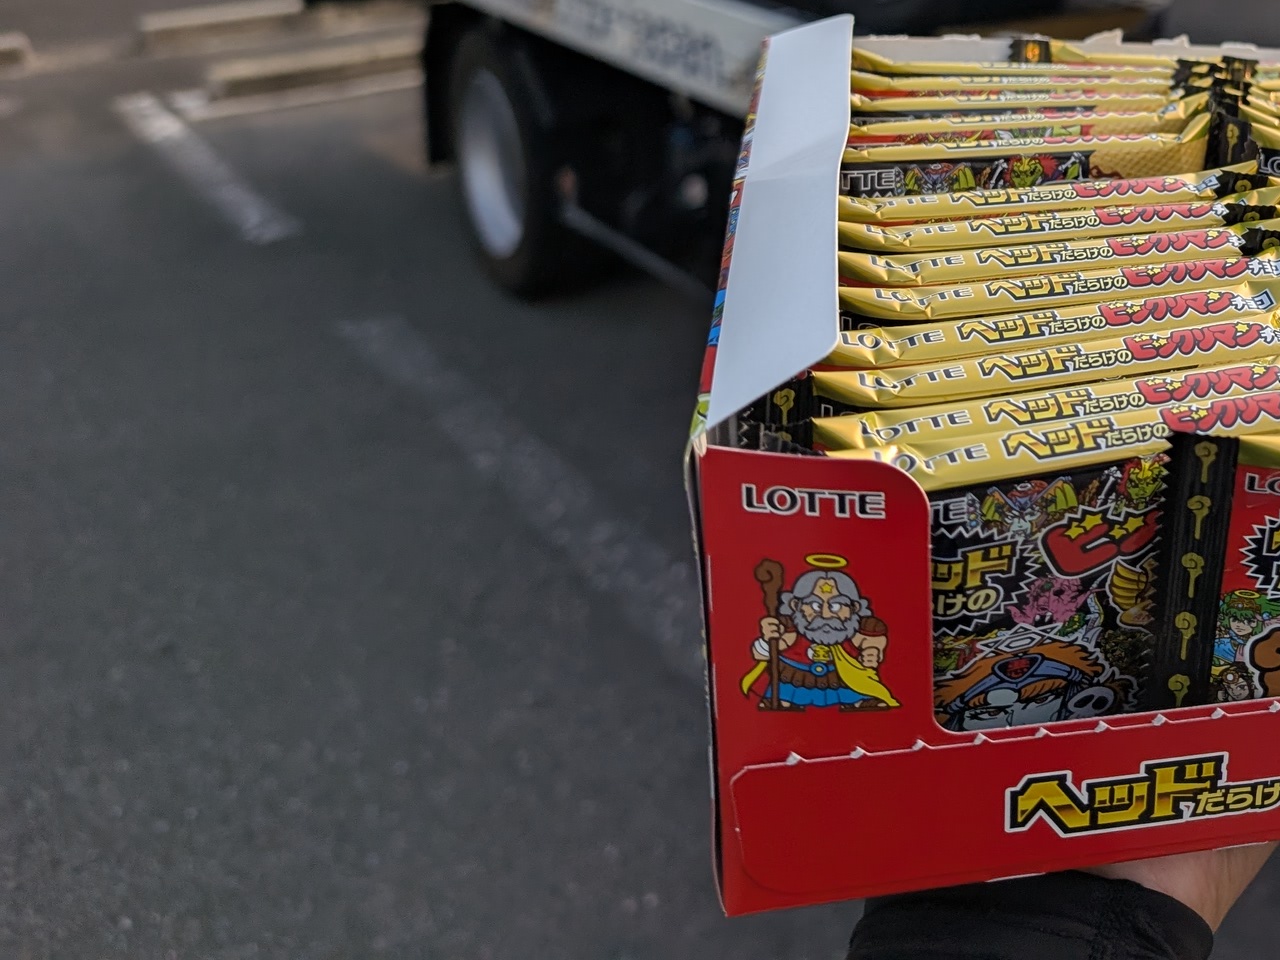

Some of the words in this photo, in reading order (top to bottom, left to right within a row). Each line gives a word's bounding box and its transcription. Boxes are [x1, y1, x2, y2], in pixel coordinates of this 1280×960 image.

[841, 169, 896, 191] TTE
[741, 483, 886, 519] LOTTE
[931, 541, 1017, 590] ッド
